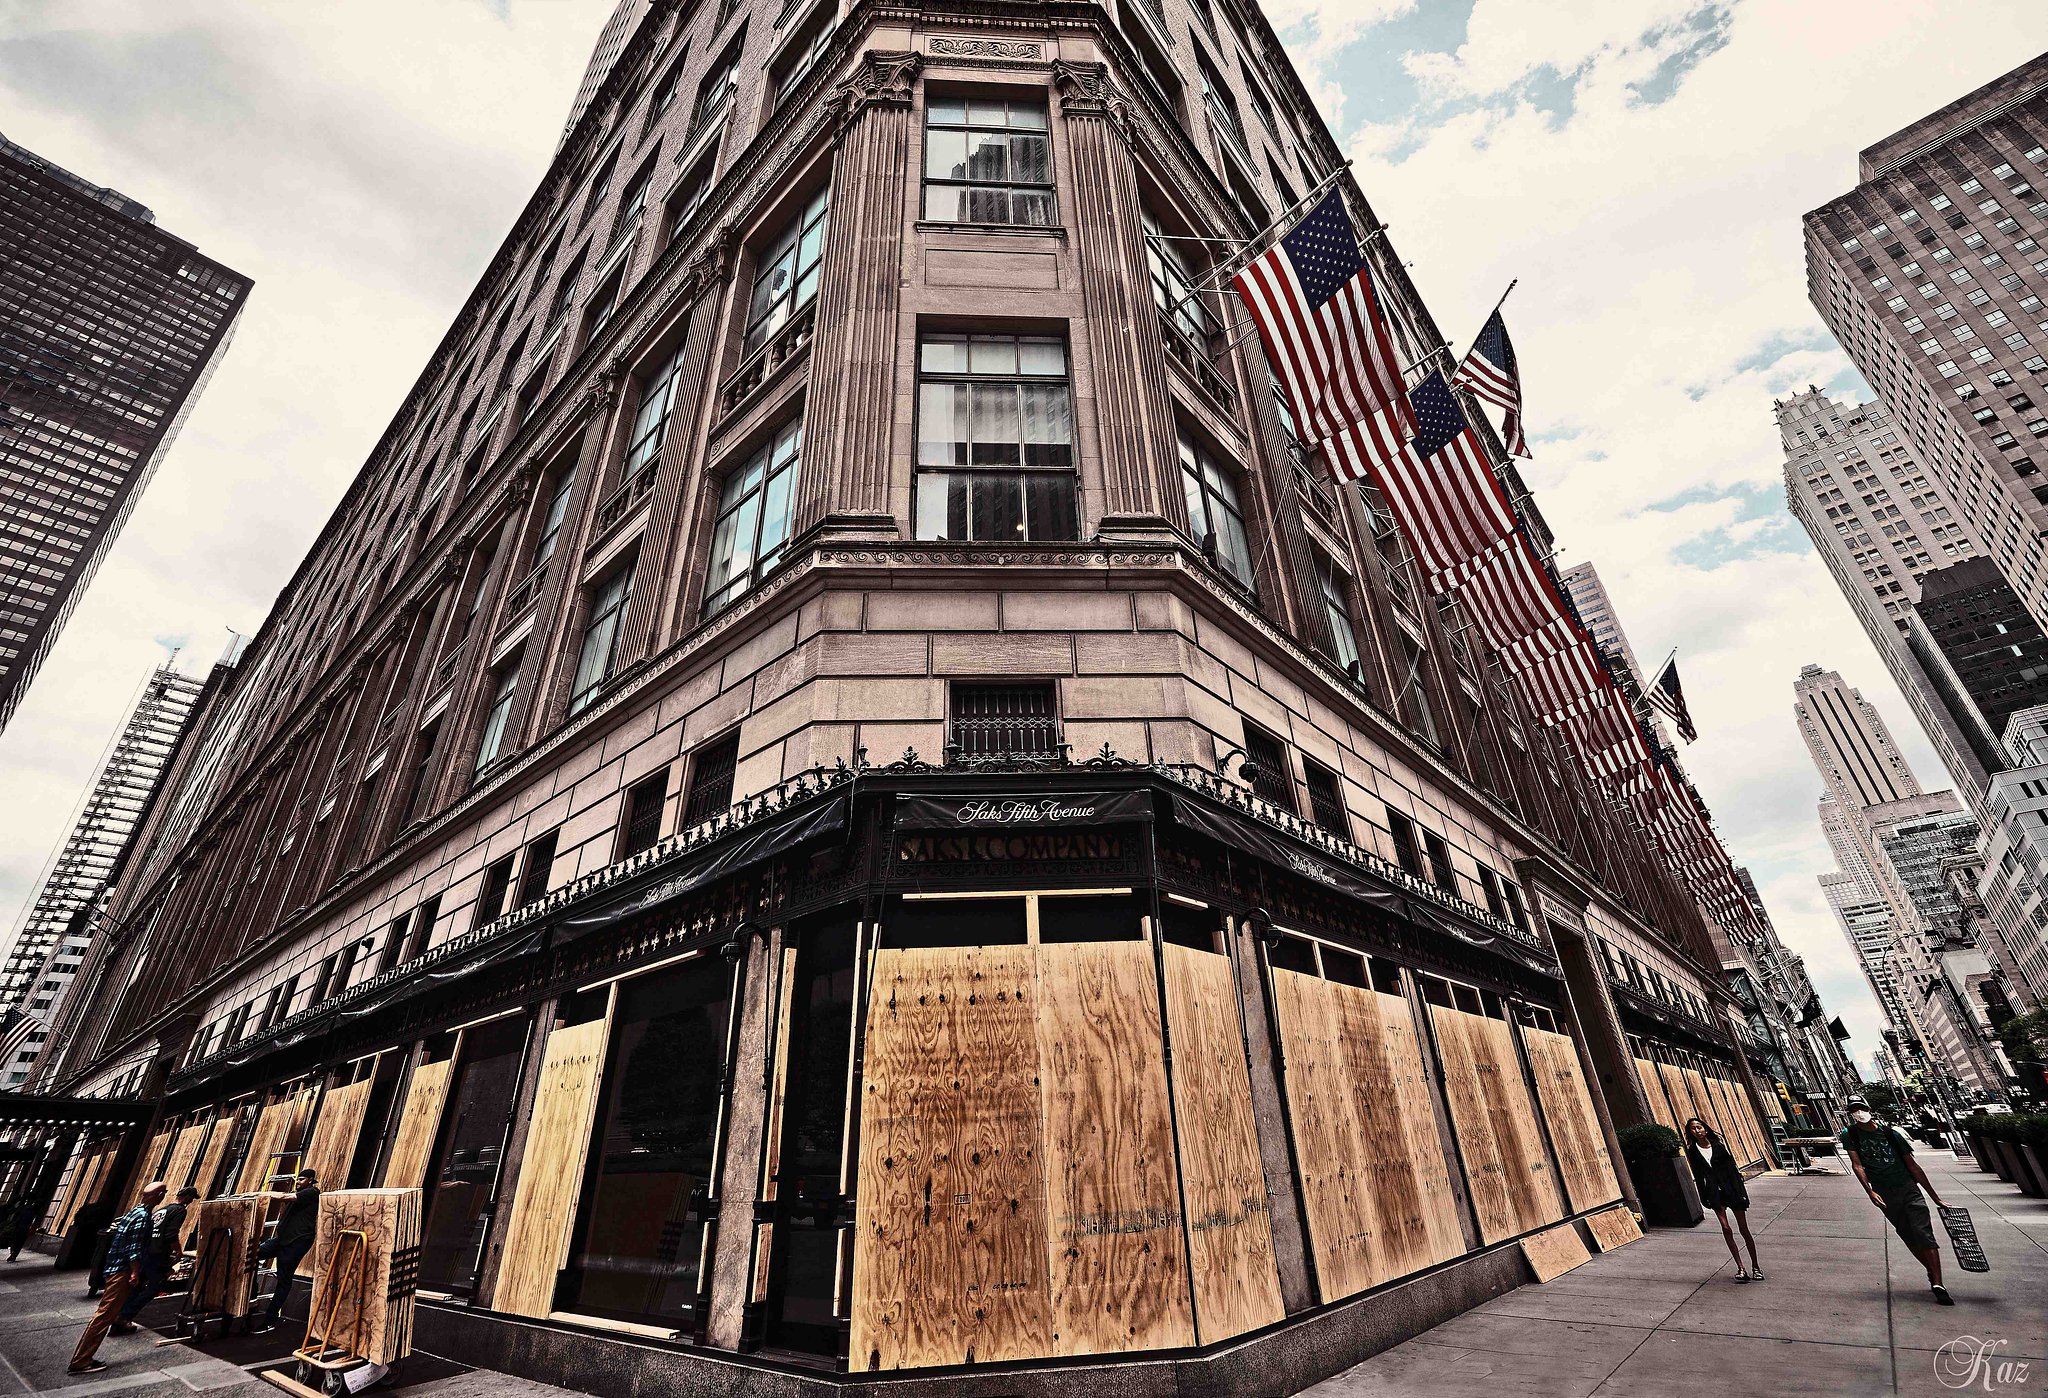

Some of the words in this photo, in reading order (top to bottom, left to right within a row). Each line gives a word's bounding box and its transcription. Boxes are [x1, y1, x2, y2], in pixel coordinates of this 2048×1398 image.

[957, 801, 1002, 823] Saks
[997, 800, 1039, 822] Fifth
[1030, 799, 1095, 821] Avenue
